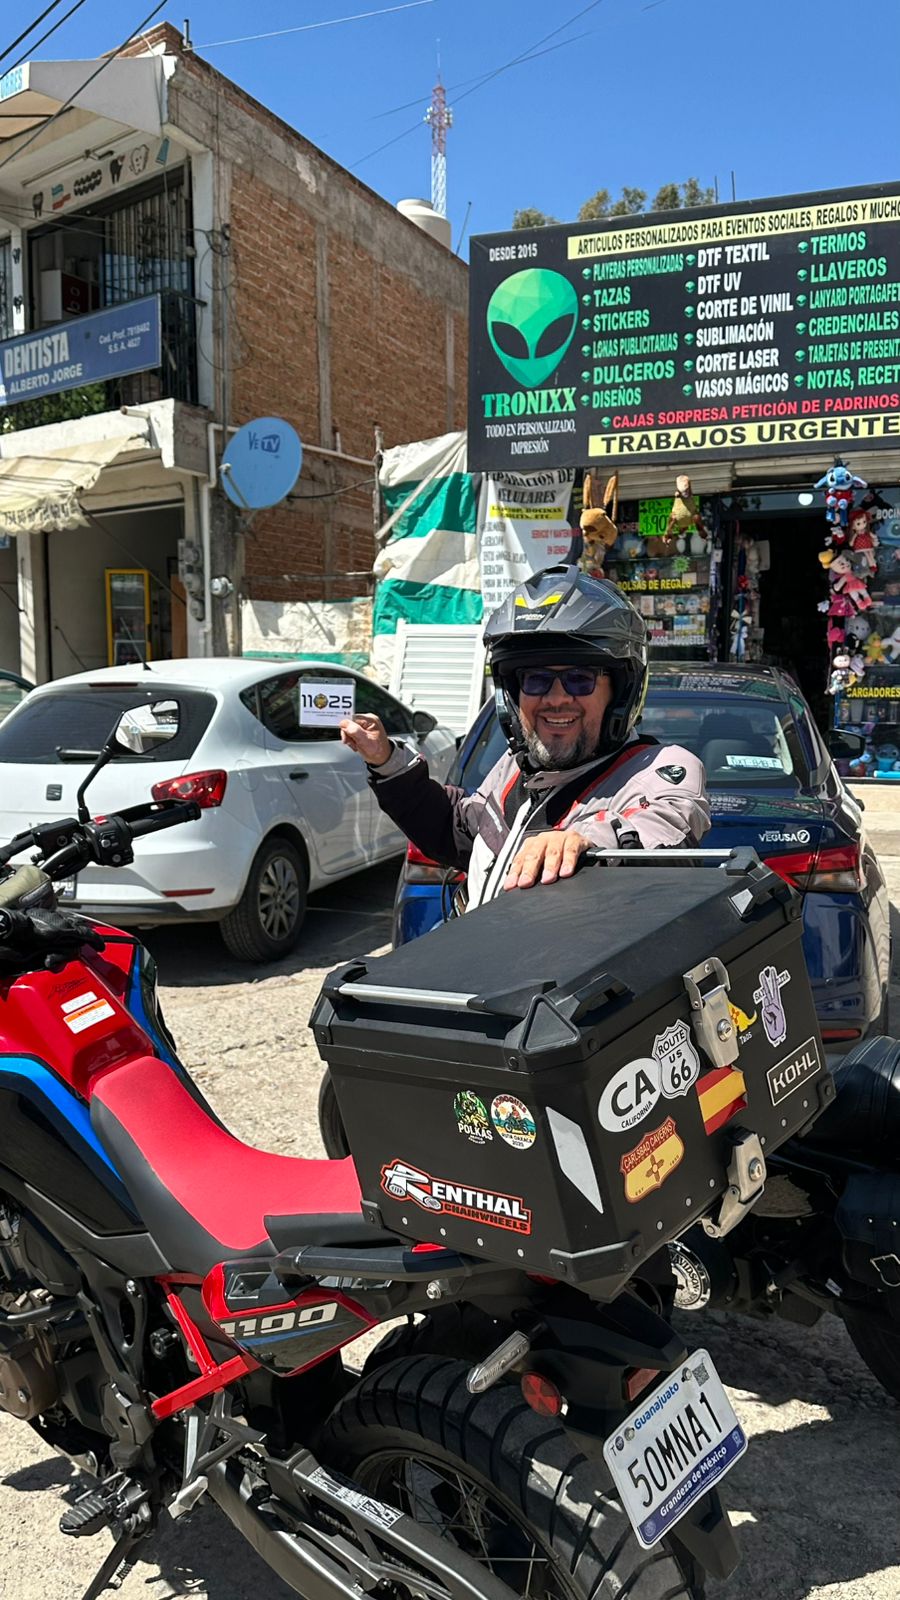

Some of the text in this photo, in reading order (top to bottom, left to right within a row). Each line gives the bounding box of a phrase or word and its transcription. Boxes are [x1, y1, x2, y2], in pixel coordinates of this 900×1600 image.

[577, 234, 622, 255] ARTICULOS
[625, 224, 699, 249] PERSONALIZADOS
[700, 220, 724, 240] PARA
[725, 215, 766, 236] EVENTOS
[768, 210, 814, 231] SOCIALES,
[816, 203, 858, 225] REGALOS
[861, 203, 868, 220] Y
[489, 243, 538, 261] DESDE 2015
[697, 241, 770, 268] DTF TEXTIL
[810, 231, 866, 255] TERMOS
[593, 253, 684, 281] PLAYERAS PERSONALIZADAS
[810, 257, 887, 283] LLAVEROS
[697, 271, 742, 294] DTF UV
[593, 286, 631, 307] TAZAS
[697, 292, 794, 320] CORTE DE VINIL
[809, 287, 847, 309] LANYARD
[593, 309, 650, 332] STICKERS
[696, 318, 774, 347] SUBLIMACIÓN
[808, 311, 899, 337] CREDENCIALES
[4, 331, 70, 378] DENTISTA
[593, 332, 678, 358] LONAS PUBLICITARIAS
[808, 338, 900, 363] TARJETAS DE PRESENT
[593, 359, 675, 385] DULCEROS
[696, 348, 779, 373] CORTE LASER
[10, 374, 49, 394] ALBERTO
[51, 363, 83, 384] JORGE
[695, 371, 789, 398] VASOS MÁGICOS
[807, 368, 854, 391] NOTAS,
[482, 387, 577, 418] TRONIXX
[592, 385, 641, 408] DISEÑOS
[612, 394, 900, 428] CAJAS SORPRESA PETICIÓN DE PADRINOS
[485, 418, 576, 438] TODO EN PERSONALIZADO,
[601, 415, 900, 454] TRABAJOS URGENTE
[511, 437, 550, 455] IMPRESIÓN
[558, 468, 574, 484] DE
[648, 580, 659, 590] DE
[661, 578, 692, 589] REGALO
[847, 686, 900, 698] CARGADORES
[657, 1029, 685, 1055] ROUTE
[668, 1049, 682, 1064] US
[671, 1058, 691, 1089] 66
[772, 1052, 816, 1094] KOHL
[611, 1069, 656, 1117] CA
[621, 1100, 653, 1128] CALIFORNIA
[458, 1121, 493, 1140] POLKAS
[623, 1122, 673, 1169] CARLSBAD CAVERNS
[444, 1203, 528, 1232] CHAINWHEELS
[220, 1302, 338, 1338] 1100
[634, 1382, 679, 1430] Guanajuato
[660, 1446, 727, 1517] Grandeza de México
